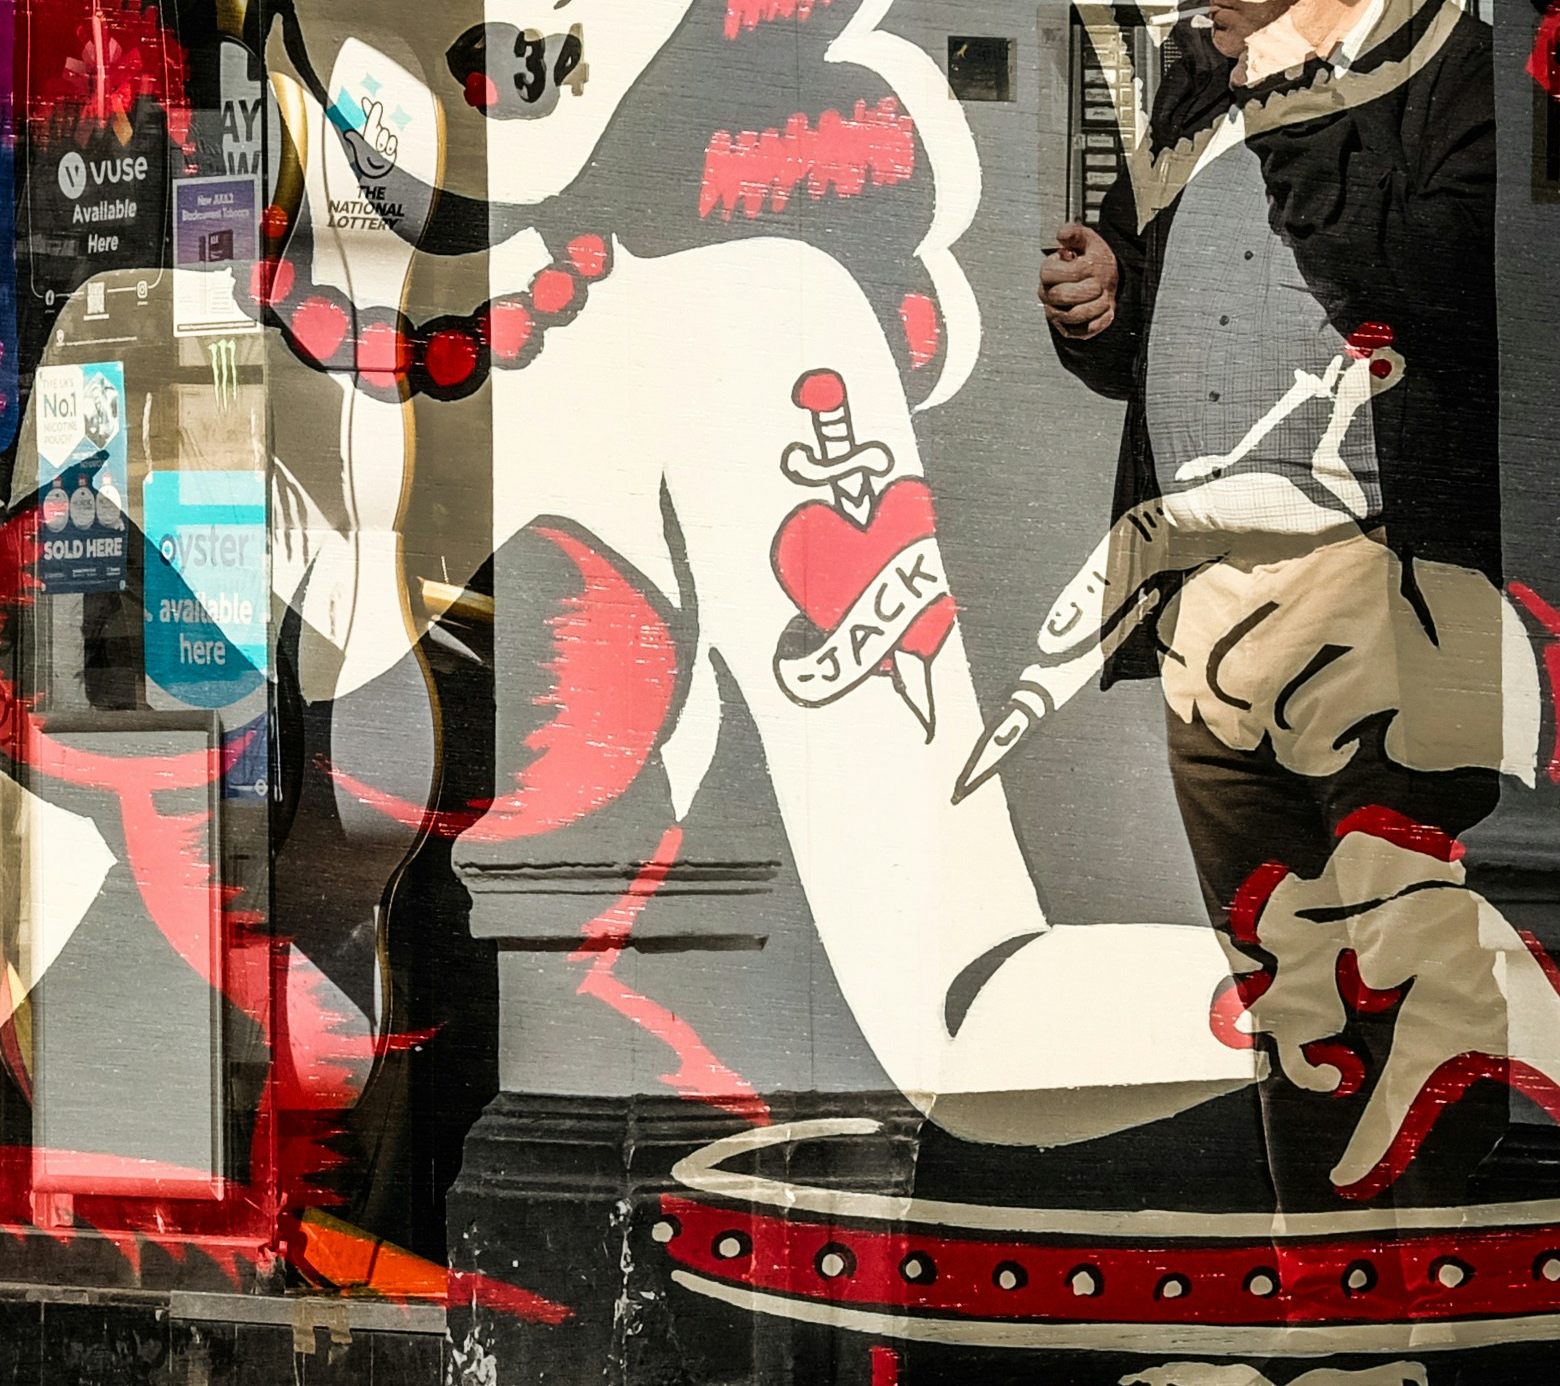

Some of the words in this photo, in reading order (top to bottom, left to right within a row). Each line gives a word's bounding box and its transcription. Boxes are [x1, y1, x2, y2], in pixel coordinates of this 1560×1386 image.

[513, 21, 590, 103] 34
[357, 185, 387, 200] THE
[72, 198, 137, 224] Available
[327, 200, 405, 217] NATIONAL
[327, 215, 404, 231] LOTTERY
[87, 233, 119, 254] Here
[43, 393, 77, 418] No.1
[43, 539, 84, 561] SOLD
[86, 537, 123, 558] HERE
[159, 525, 248, 576] oyster
[159, 592, 254, 624] available
[180, 632, 226, 665] here
